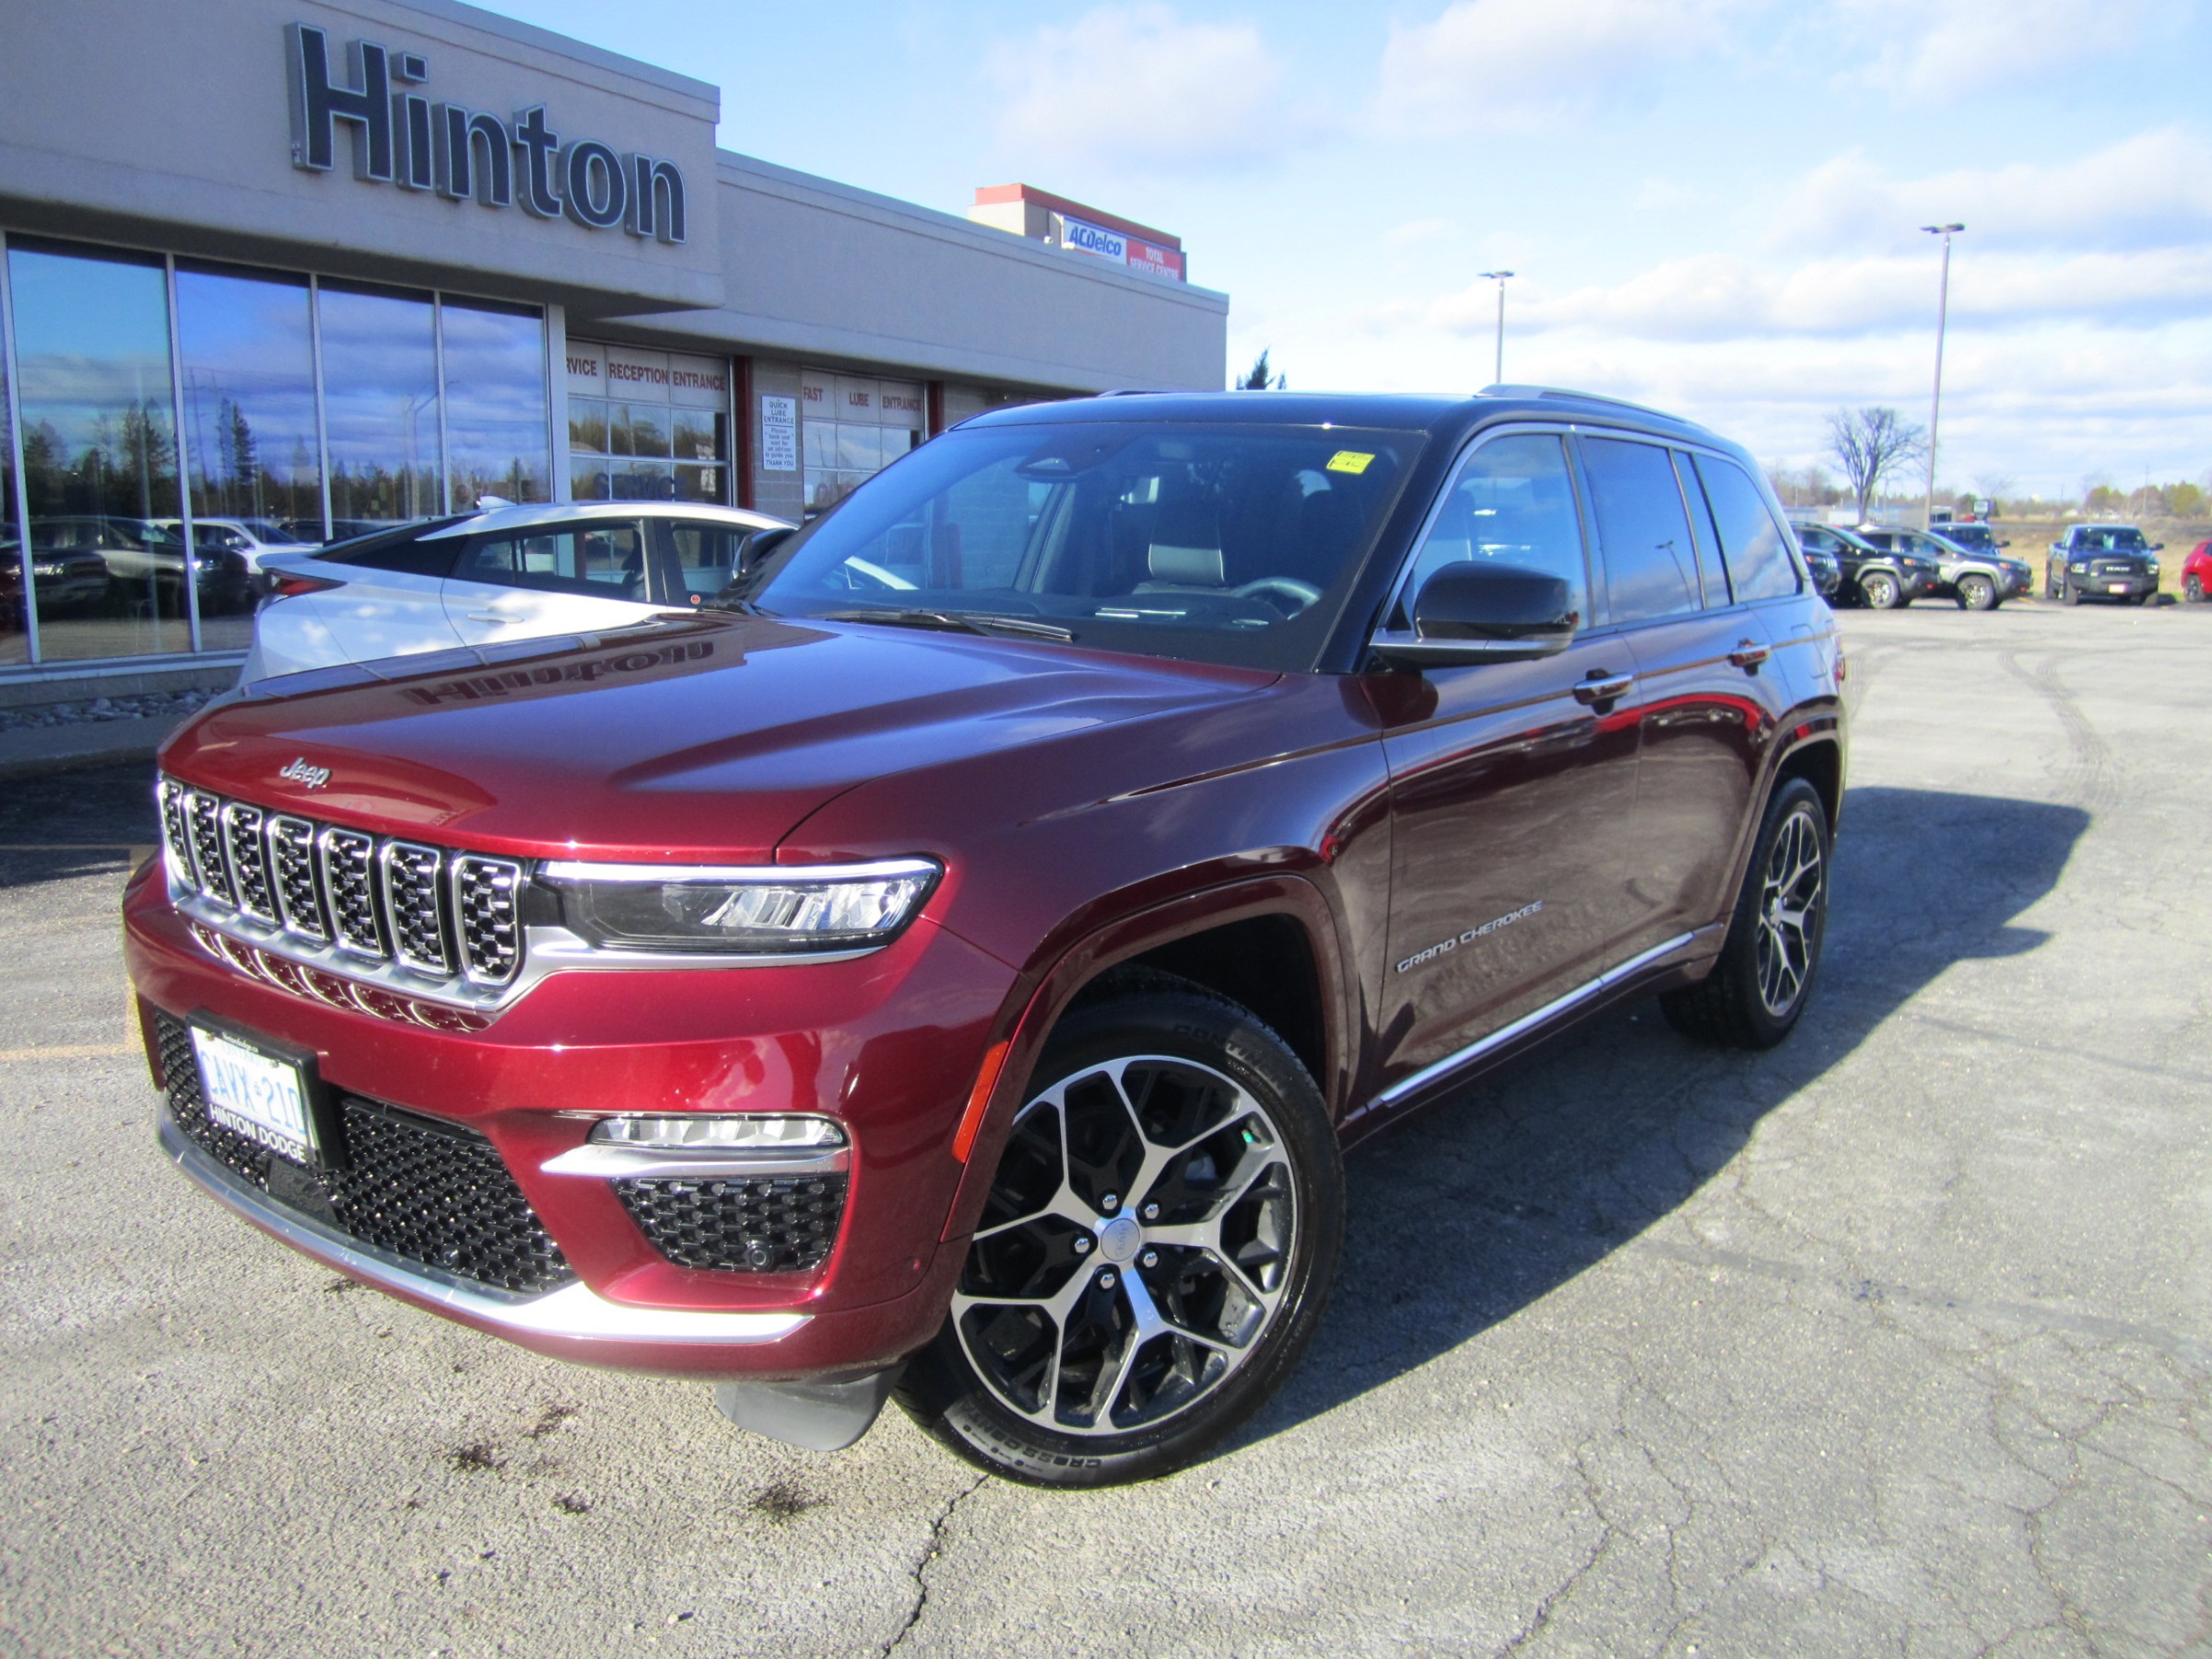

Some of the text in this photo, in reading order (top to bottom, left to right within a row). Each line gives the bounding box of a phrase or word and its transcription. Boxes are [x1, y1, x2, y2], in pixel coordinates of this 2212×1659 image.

[285, 21, 686, 244] Hinton
[1069, 226, 1122, 256] ACDelco
[566, 358, 725, 392] RVICE RECEPTION ENTRANCE
[769, 401, 788, 409] QUICK
[803, 386, 922, 412] FAST LUBE ENTRANCE
[764, 415, 794, 424] ENTRANCE
[279, 758, 331, 789] Jeep
[1395, 900, 1543, 973] GRAND CHEROKEE
[209, 1103, 307, 1163] HINTON DODGE
